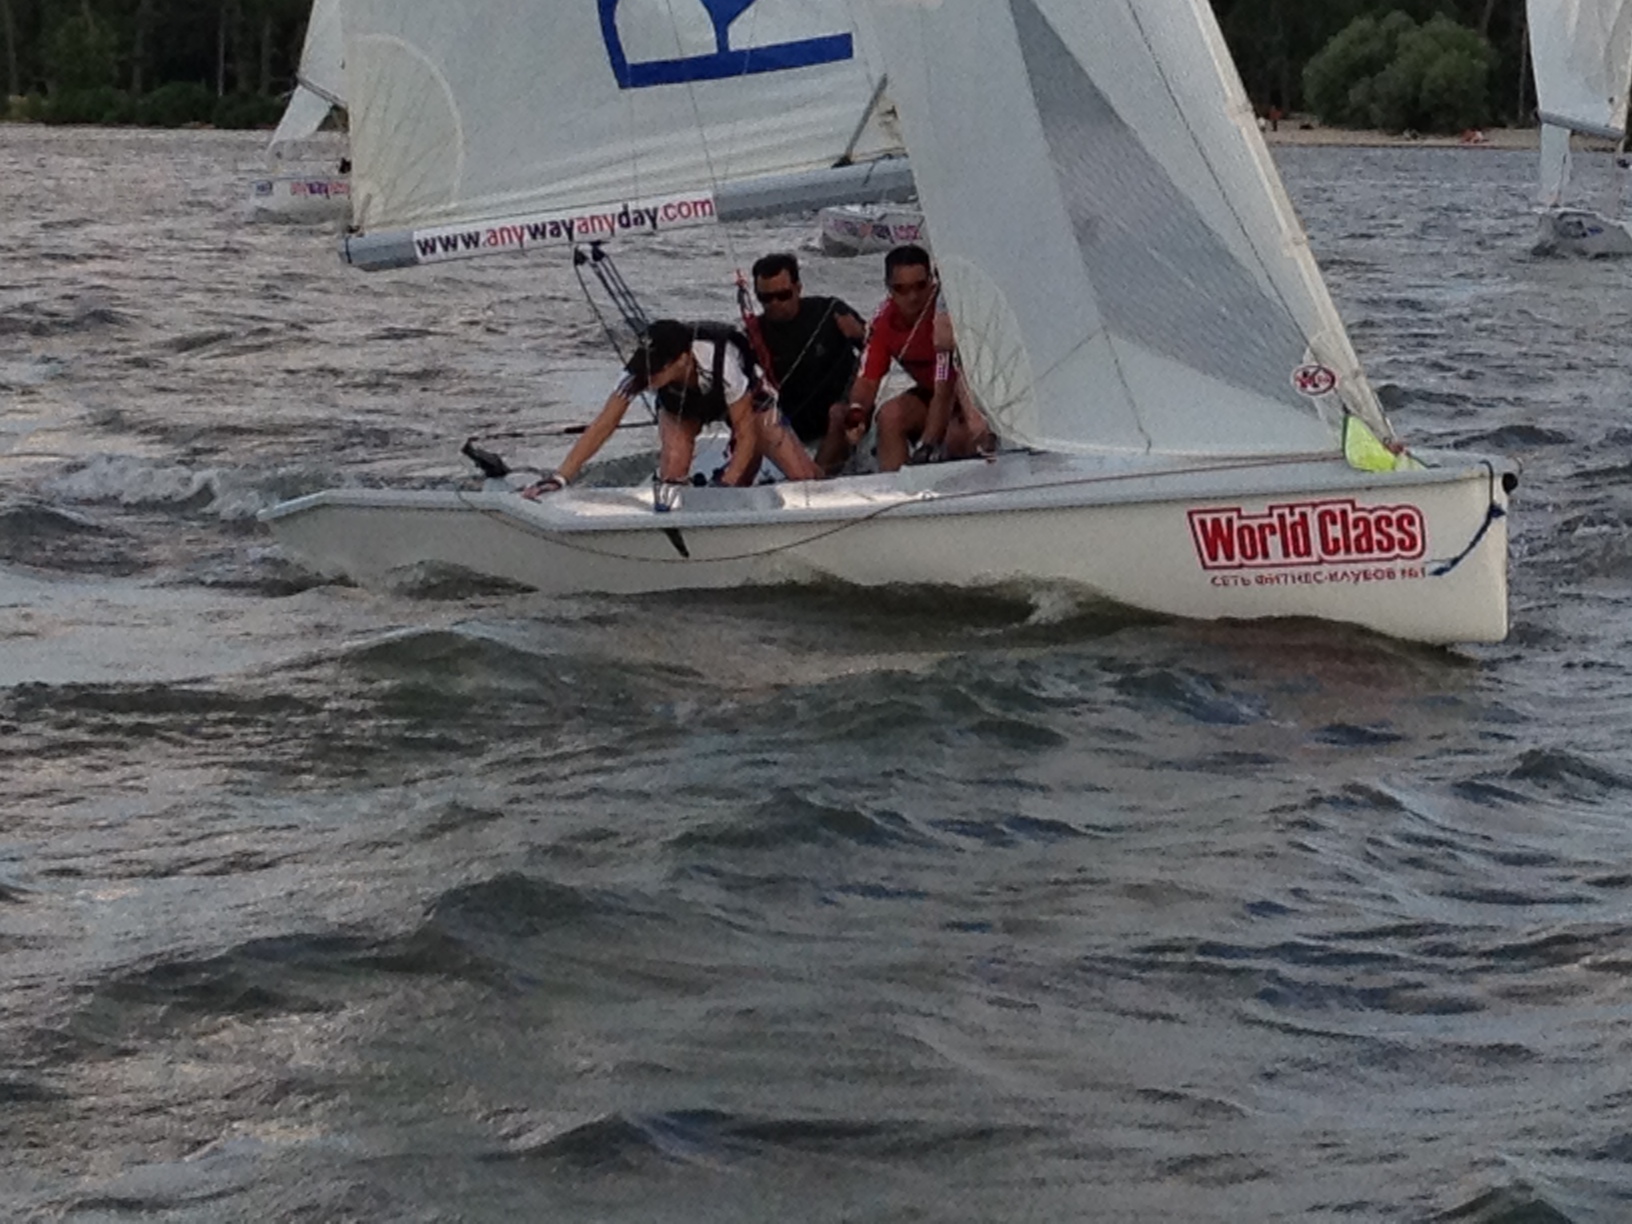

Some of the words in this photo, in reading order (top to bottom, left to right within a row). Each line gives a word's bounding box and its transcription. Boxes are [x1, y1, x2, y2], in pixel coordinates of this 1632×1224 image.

[416, 196, 714, 257] www.anywayanyday.com
[1199, 509, 1312, 562] World
[1318, 508, 1418, 557] Class
